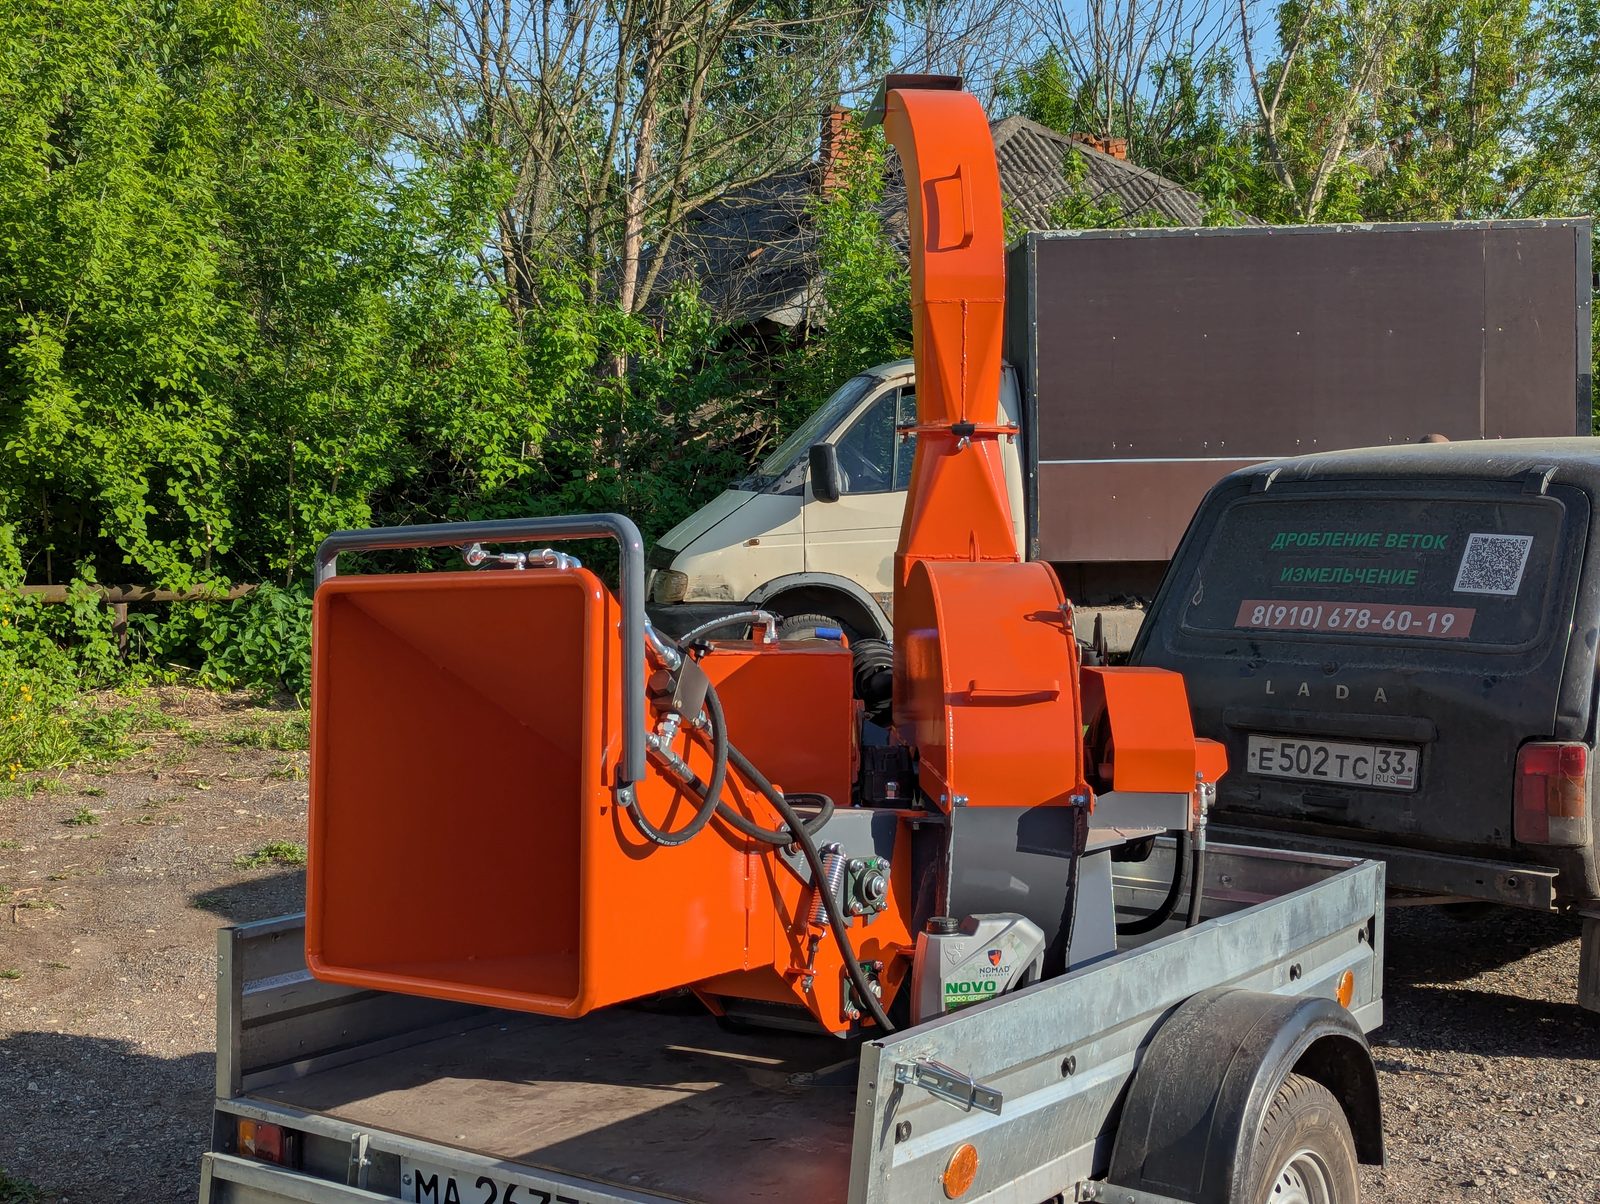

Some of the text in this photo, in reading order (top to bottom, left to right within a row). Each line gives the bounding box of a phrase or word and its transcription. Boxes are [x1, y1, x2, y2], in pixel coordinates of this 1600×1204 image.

[1271, 532, 1448, 550] ДРОБЛЕНИЕ ВЕТОК
[1280, 567, 1418, 585] ИЗМЕЛЬЧЕНИЕ
[1251, 604, 1455, 634] 8(910) 678-60-19
[1265, 680, 1387, 702] LADA
[1377, 750, 1406, 774] 33
[1375, 774, 1396, 784] RUS
[979, 965, 1010, 974] NOMAD
[945, 980, 997, 993] NOVO
